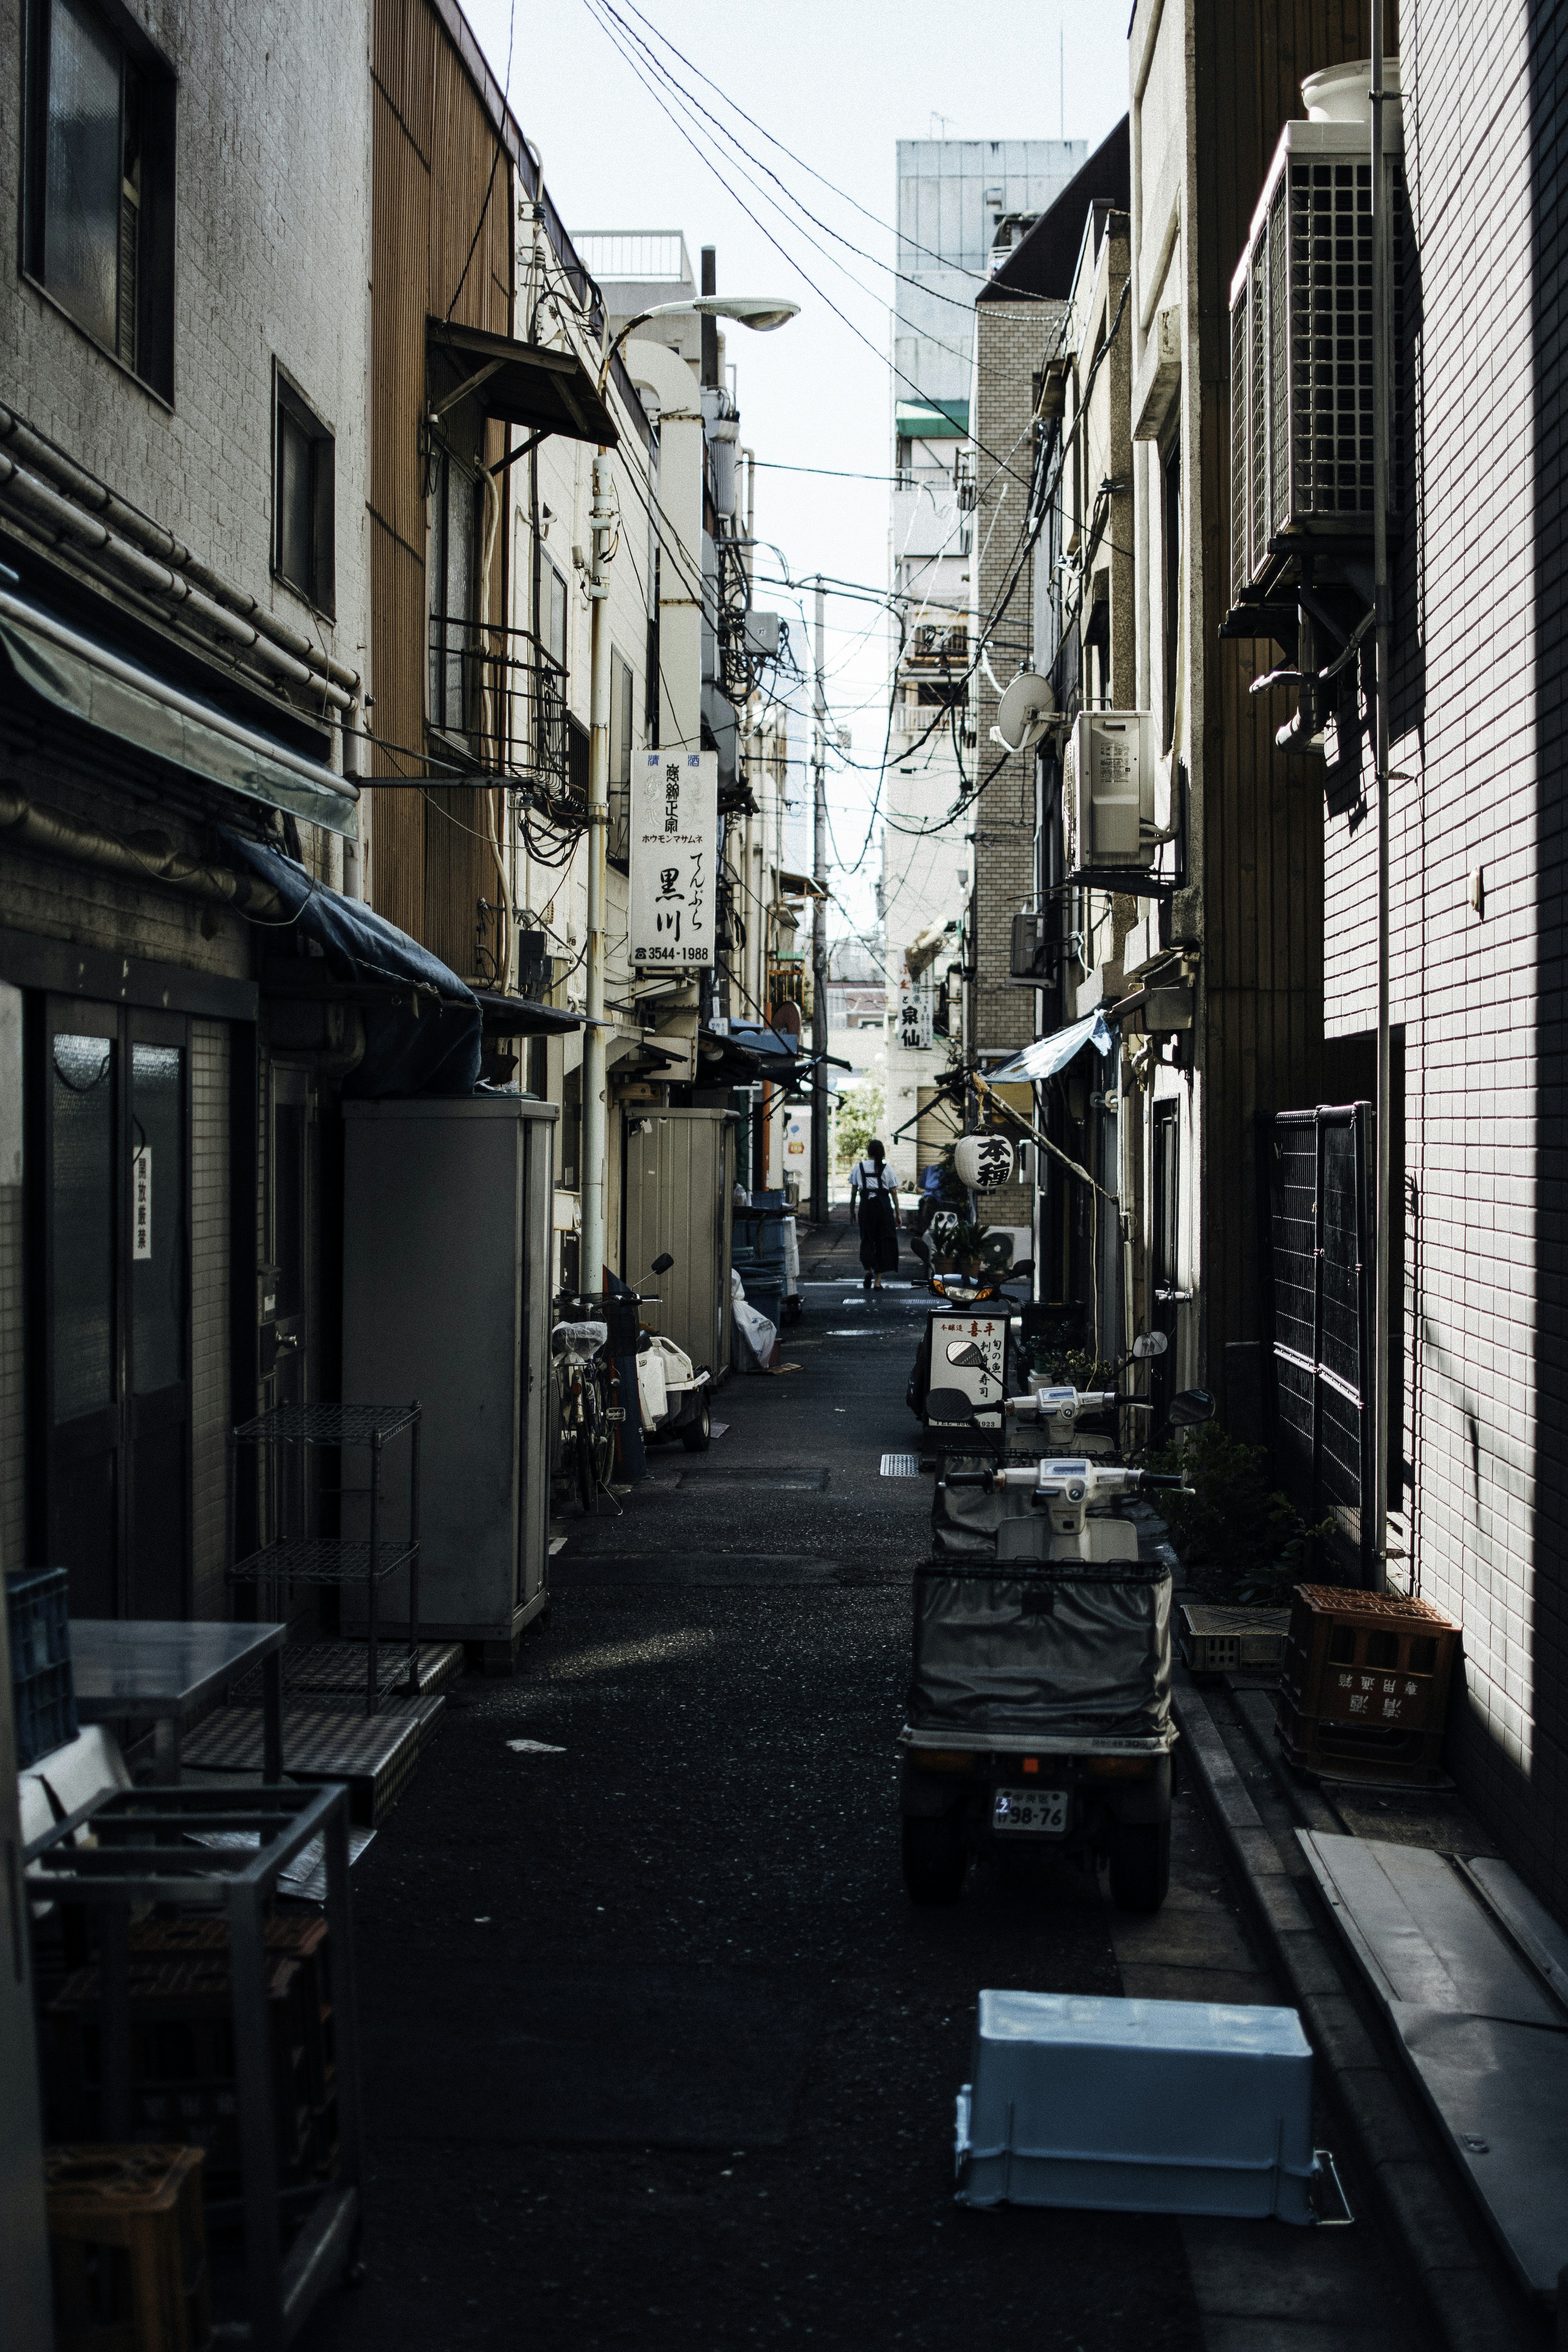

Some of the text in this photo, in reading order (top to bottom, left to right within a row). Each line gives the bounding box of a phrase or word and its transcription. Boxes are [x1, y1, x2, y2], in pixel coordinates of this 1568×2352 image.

[642, 835, 703, 843] ホウモンマサムネ
[688, 852, 705, 931] てんぷら
[655, 868, 685, 942] 黒川
[648, 947, 708, 960] 3544-1988
[901, 1005, 920, 1047] 泉仙
[940, 1320, 995, 1337] 本醸造 喜平
[991, 1339, 1002, 1373] 旬の魚
[1338, 1674, 1418, 1695] 専用通箱
[1348, 1695, 1402, 1718] 清酒
